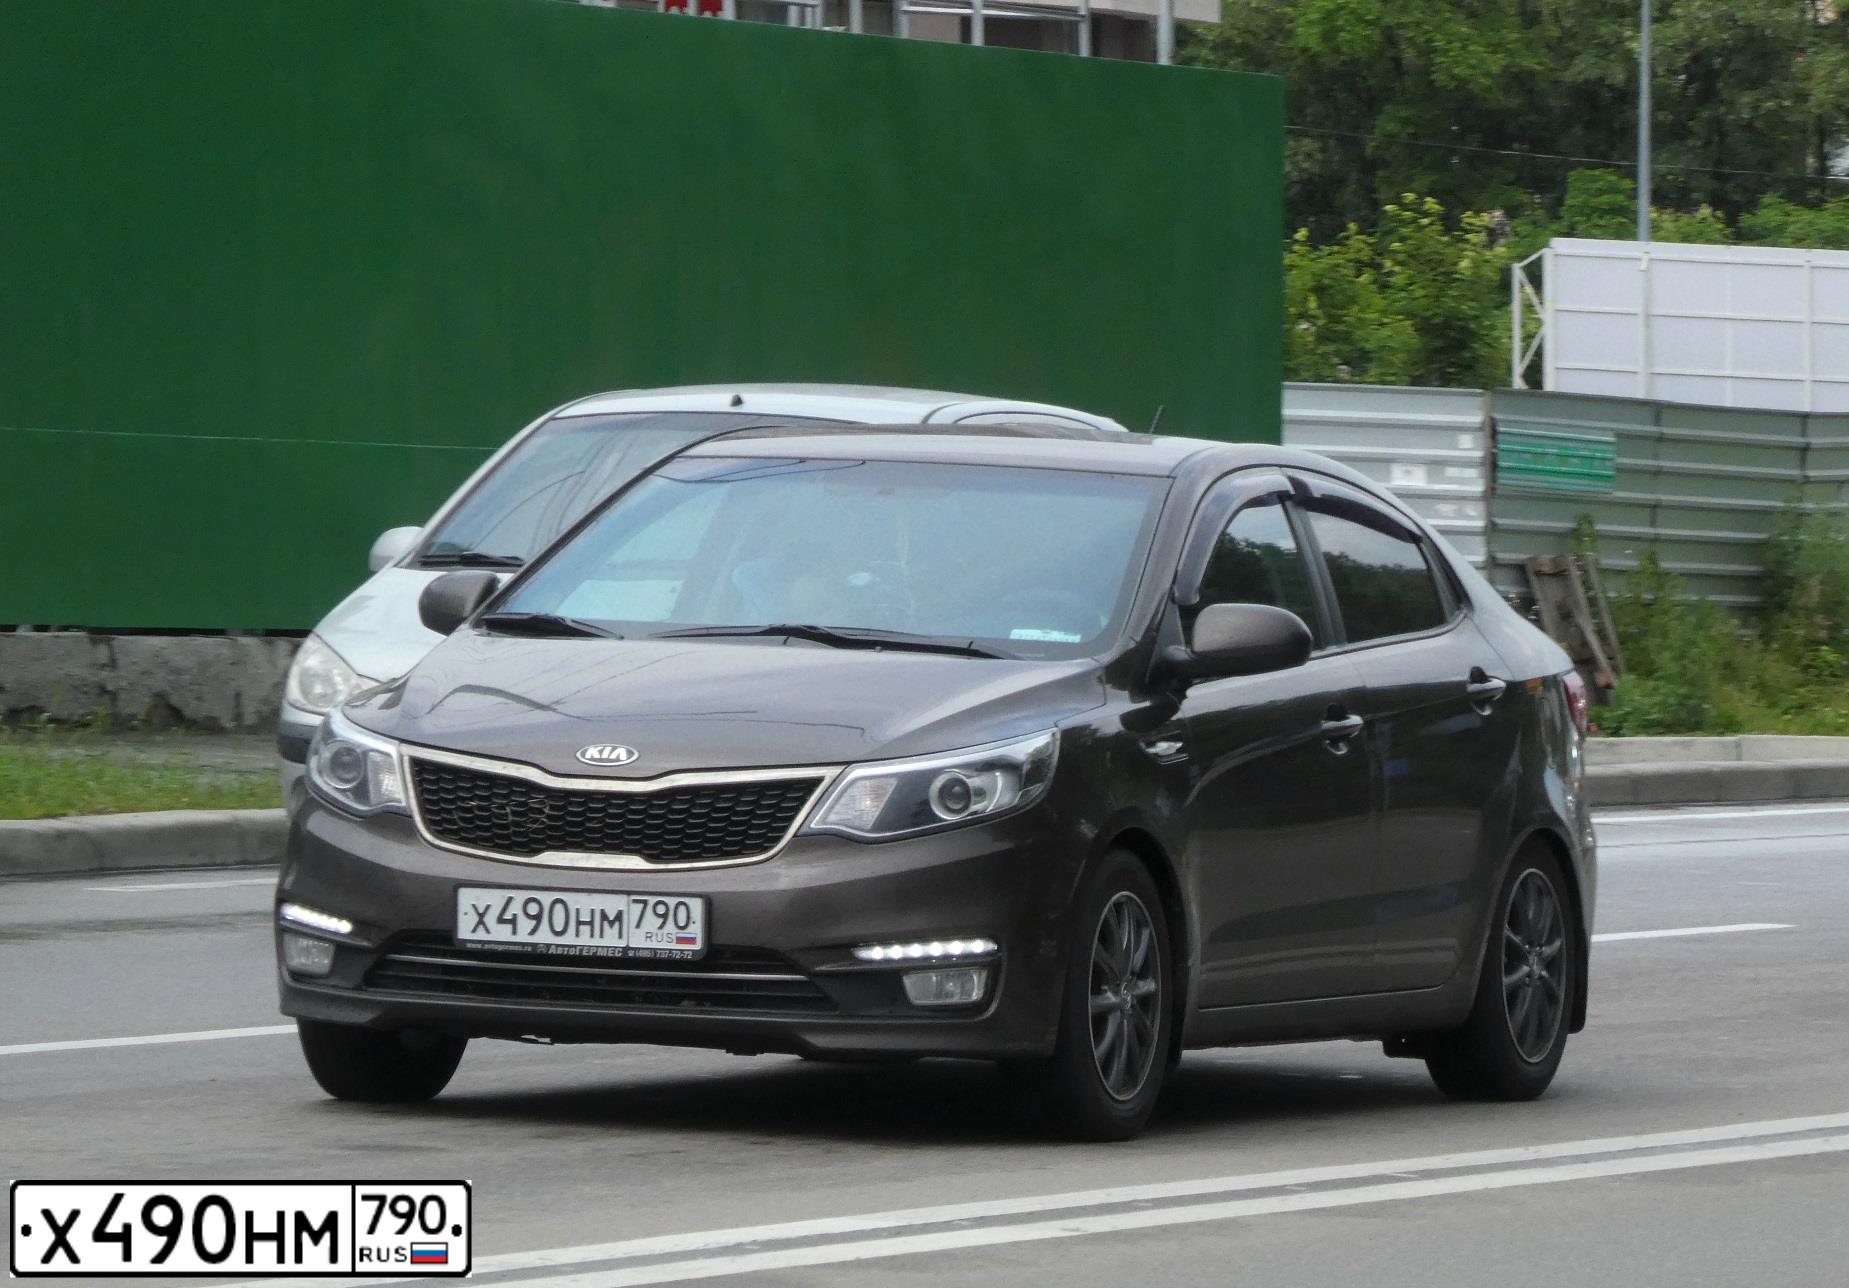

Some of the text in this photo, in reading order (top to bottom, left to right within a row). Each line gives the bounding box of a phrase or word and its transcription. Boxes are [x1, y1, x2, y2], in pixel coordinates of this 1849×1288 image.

[585, 746, 627, 760] KIA
[632, 898, 691, 930] 790
[644, 931, 673, 944] RUS
